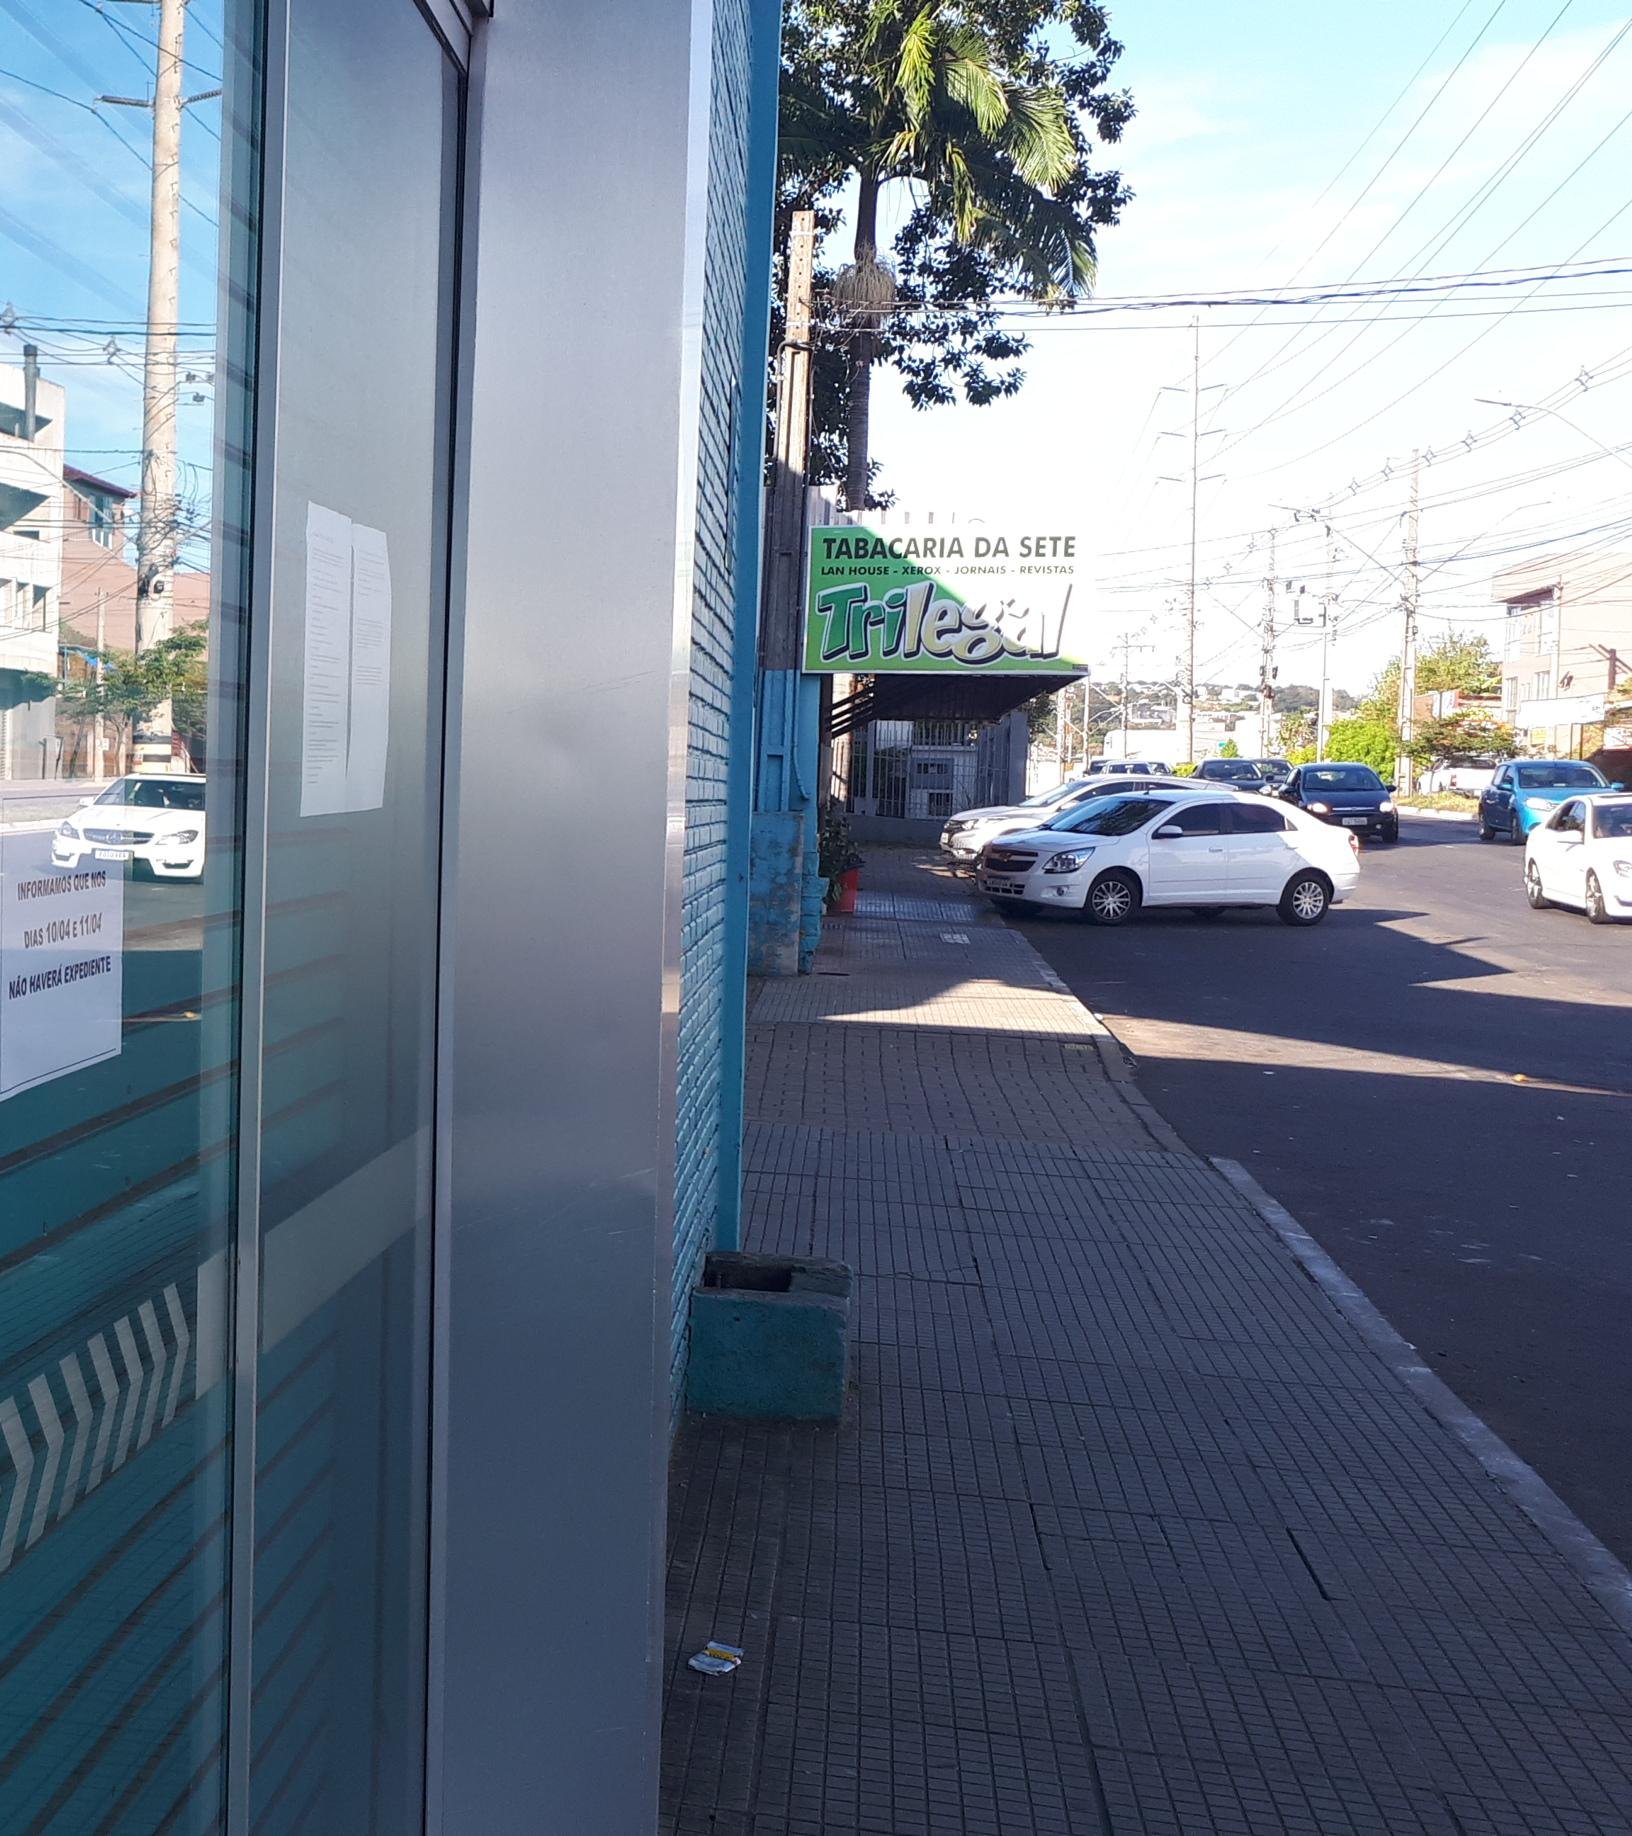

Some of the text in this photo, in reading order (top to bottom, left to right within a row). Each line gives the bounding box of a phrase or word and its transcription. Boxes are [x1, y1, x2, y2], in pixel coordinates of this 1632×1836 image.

[823, 535, 1076, 559] TABACARIA DA SETE
[821, 566, 845, 576] LAN
[848, 566, 890, 576] HOUSE
[901, 566, 942, 576] XEROX
[954, 565, 1007, 575] JORNAIS
[1019, 565, 1075, 575] REVISTAS
[17, 870, 106, 901] INFORMAMOS QUE NOS
[24, 912, 102, 949] DIAS 10/04 E 11/04
[9, 956, 111, 1000] NÃO HAVERÁ EXPEDIENTE
